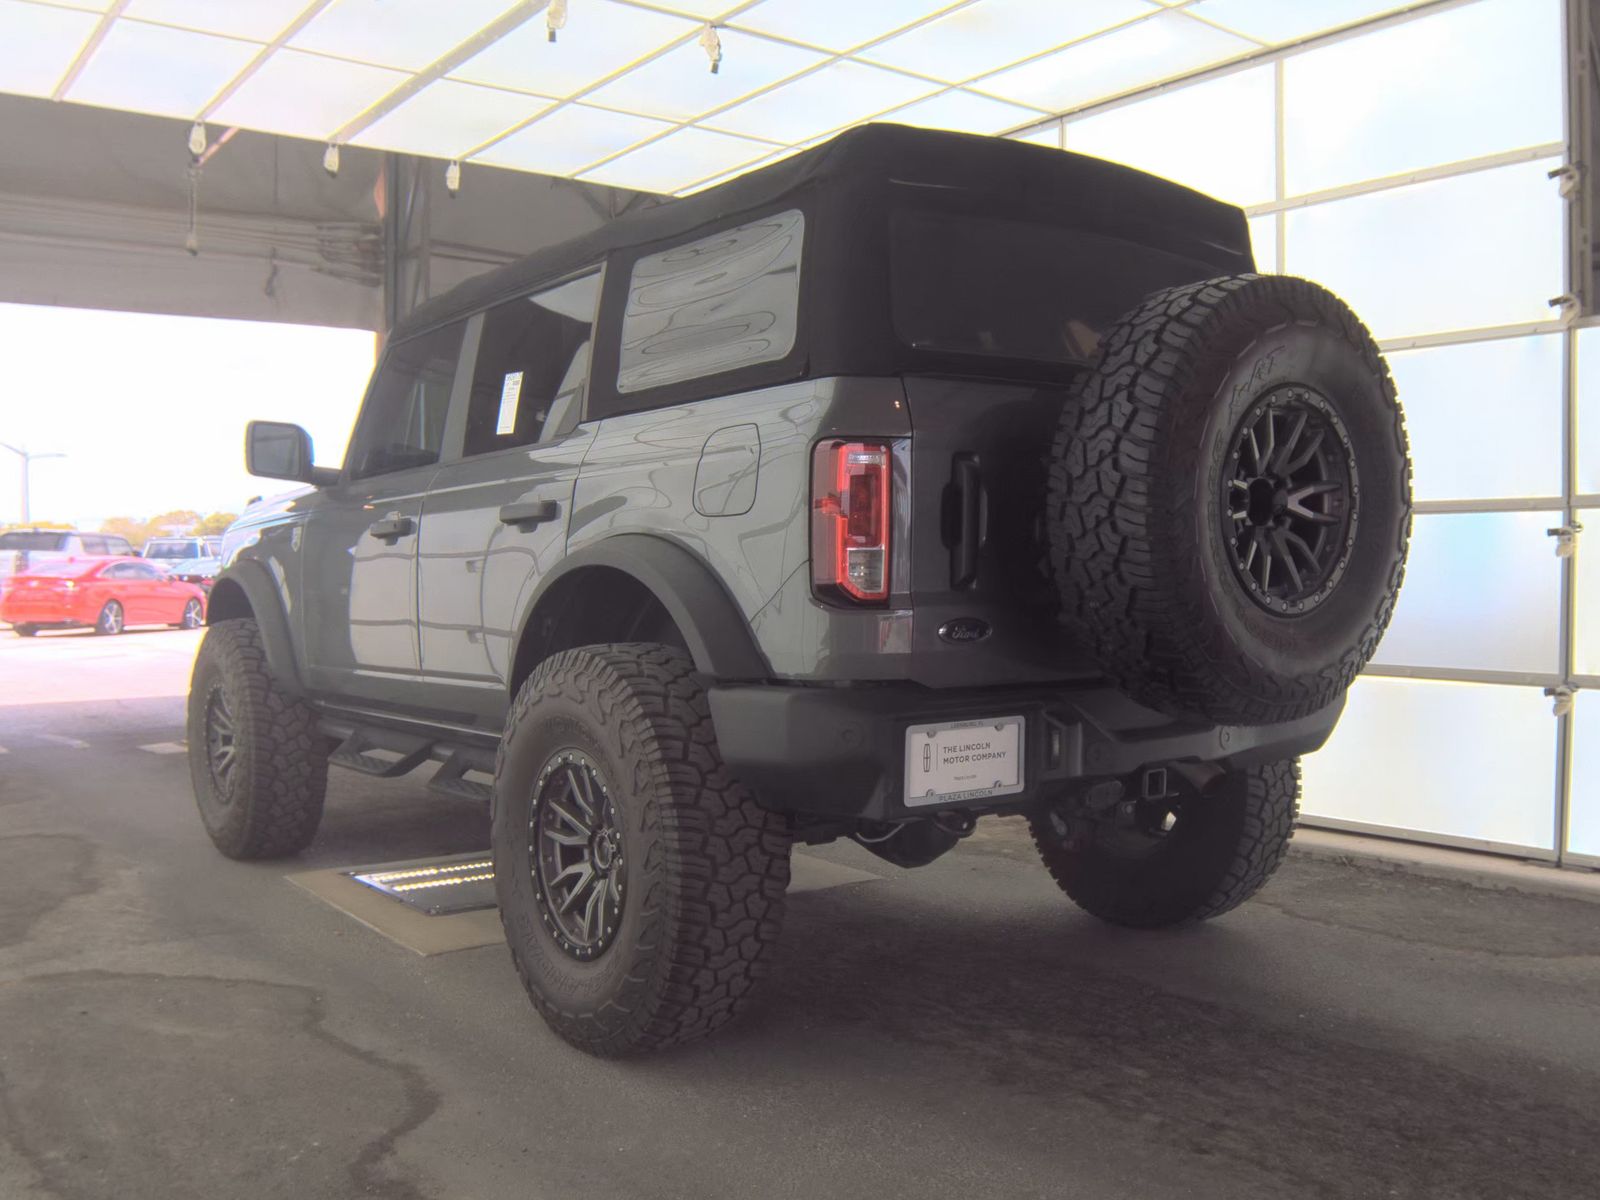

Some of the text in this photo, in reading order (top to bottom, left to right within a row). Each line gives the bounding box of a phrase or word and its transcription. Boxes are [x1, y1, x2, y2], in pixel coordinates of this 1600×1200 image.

[943, 742, 991, 753] THE LINCOLN
[943, 752, 1007, 765] MOTOR COMPANY
[938, 790, 993, 802] PLAZA LINCOLN
